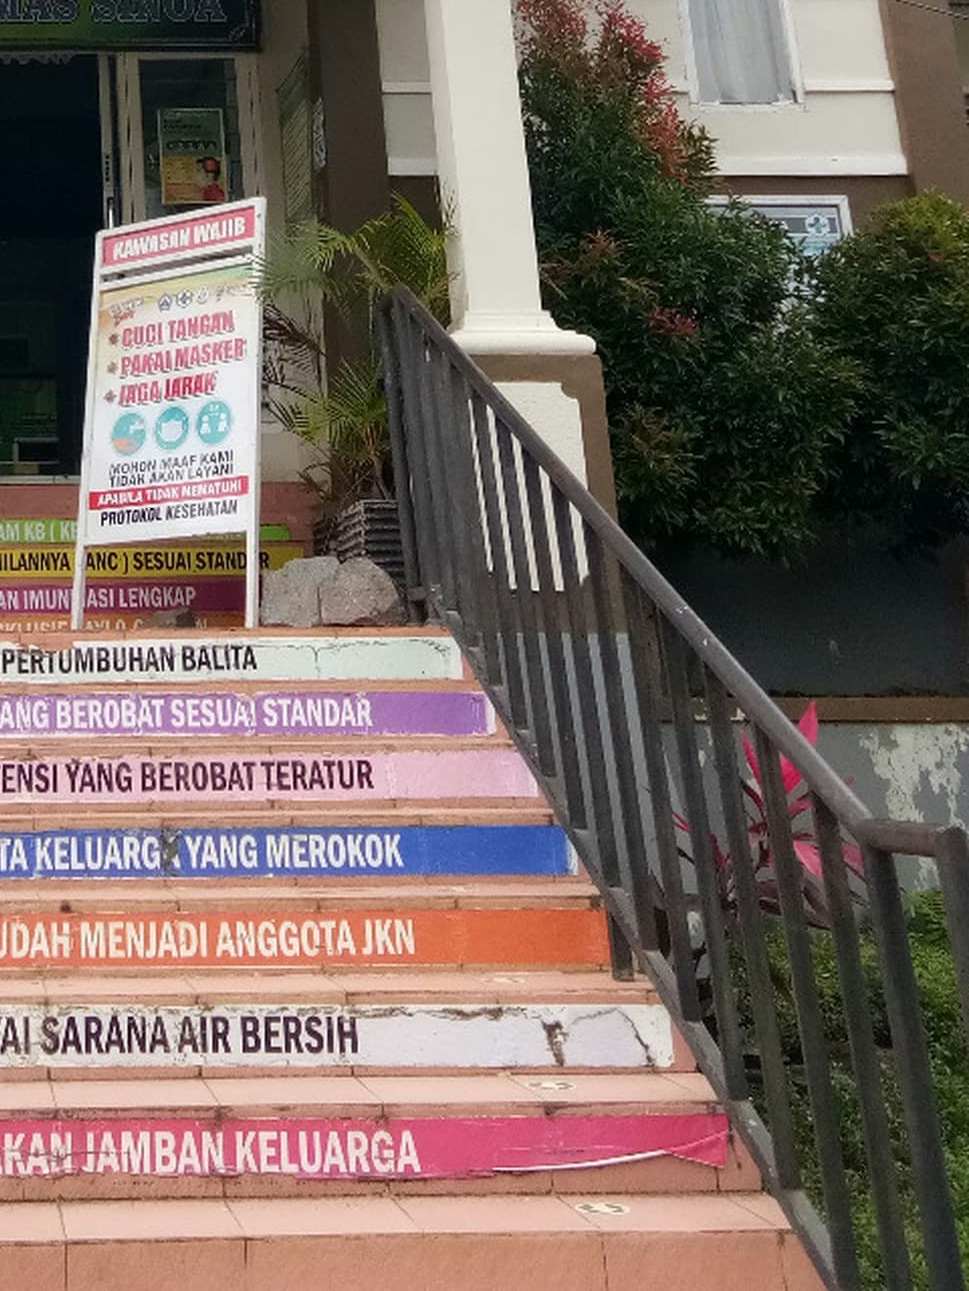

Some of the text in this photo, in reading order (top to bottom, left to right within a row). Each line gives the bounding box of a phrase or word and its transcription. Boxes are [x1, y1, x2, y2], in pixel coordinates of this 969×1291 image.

[113, 216, 246, 260] KAWASAN WAJIB
[122, 322, 163, 348] CUCI
[168, 310, 236, 342] TANGAN
[120, 338, 246, 378] PAKAI MASKER
[119, 371, 218, 407] JAGA JARAK
[109, 450, 233, 476] MOHON MAAF KAMI
[109, 464, 233, 488] TIDAK AKAN LAYANI
[145, 486, 179, 501] TIDAK
[100, 500, 238, 527] PROTOKOL KESEHATAN
[25, 522, 46, 541] KB
[133, 552, 191, 571] SESUAI
[195, 551, 270, 570] STANDR
[23, 588, 115, 610] IMUNASI
[119, 587, 196, 608] LENGKAP
[2, 646, 175, 675] PERTUMBUHAN
[182, 645, 258, 671] BALITA
[56, 698, 166, 729] BEROBAT
[171, 699, 256, 728] SESUAI
[263, 698, 373, 727] STANDAR
[65, 760, 132, 793] YANG
[141, 761, 258, 792] BEROBAT
[260, 759, 374, 791] TERATUR
[186, 835, 257, 869] YANG
[266, 834, 404, 869] MEROKOK
[80, 921, 208, 959] MENJADI
[216, 920, 356, 957] ANGGOTA
[362, 919, 416, 956] JKN
[40, 1015, 171, 1055] SARANA
[177, 1015, 231, 1054] AIR
[240, 1015, 358, 1054] BERSIH
[82, 1130, 225, 1174] JAMBAN
[235, 1129, 422, 1174] KELUARGA
